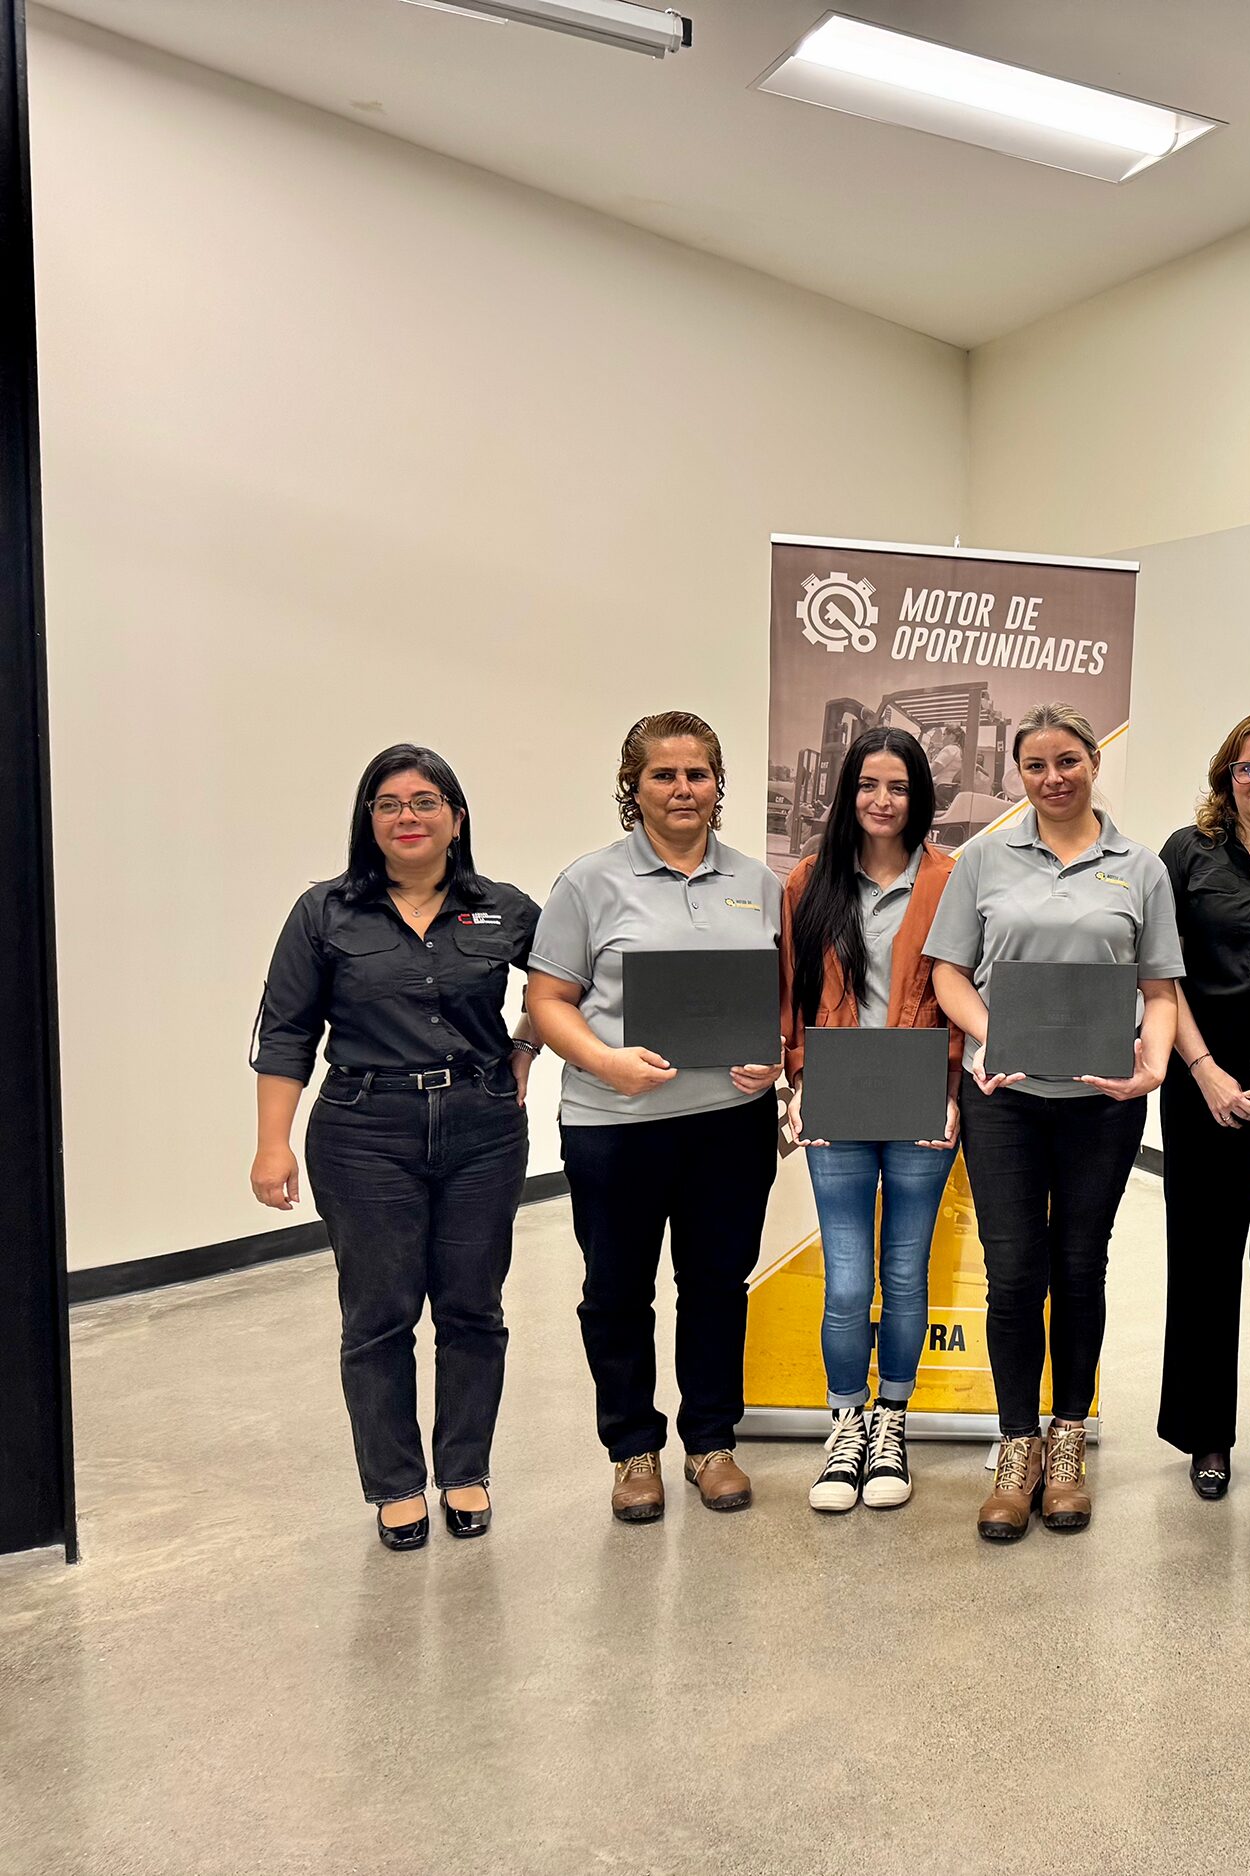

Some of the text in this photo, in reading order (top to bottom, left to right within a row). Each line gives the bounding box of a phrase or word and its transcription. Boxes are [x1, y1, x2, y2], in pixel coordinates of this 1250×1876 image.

[898, 587, 1044, 631] MOTOR DE
[890, 625, 1109, 676] OPORTUNIDADES
